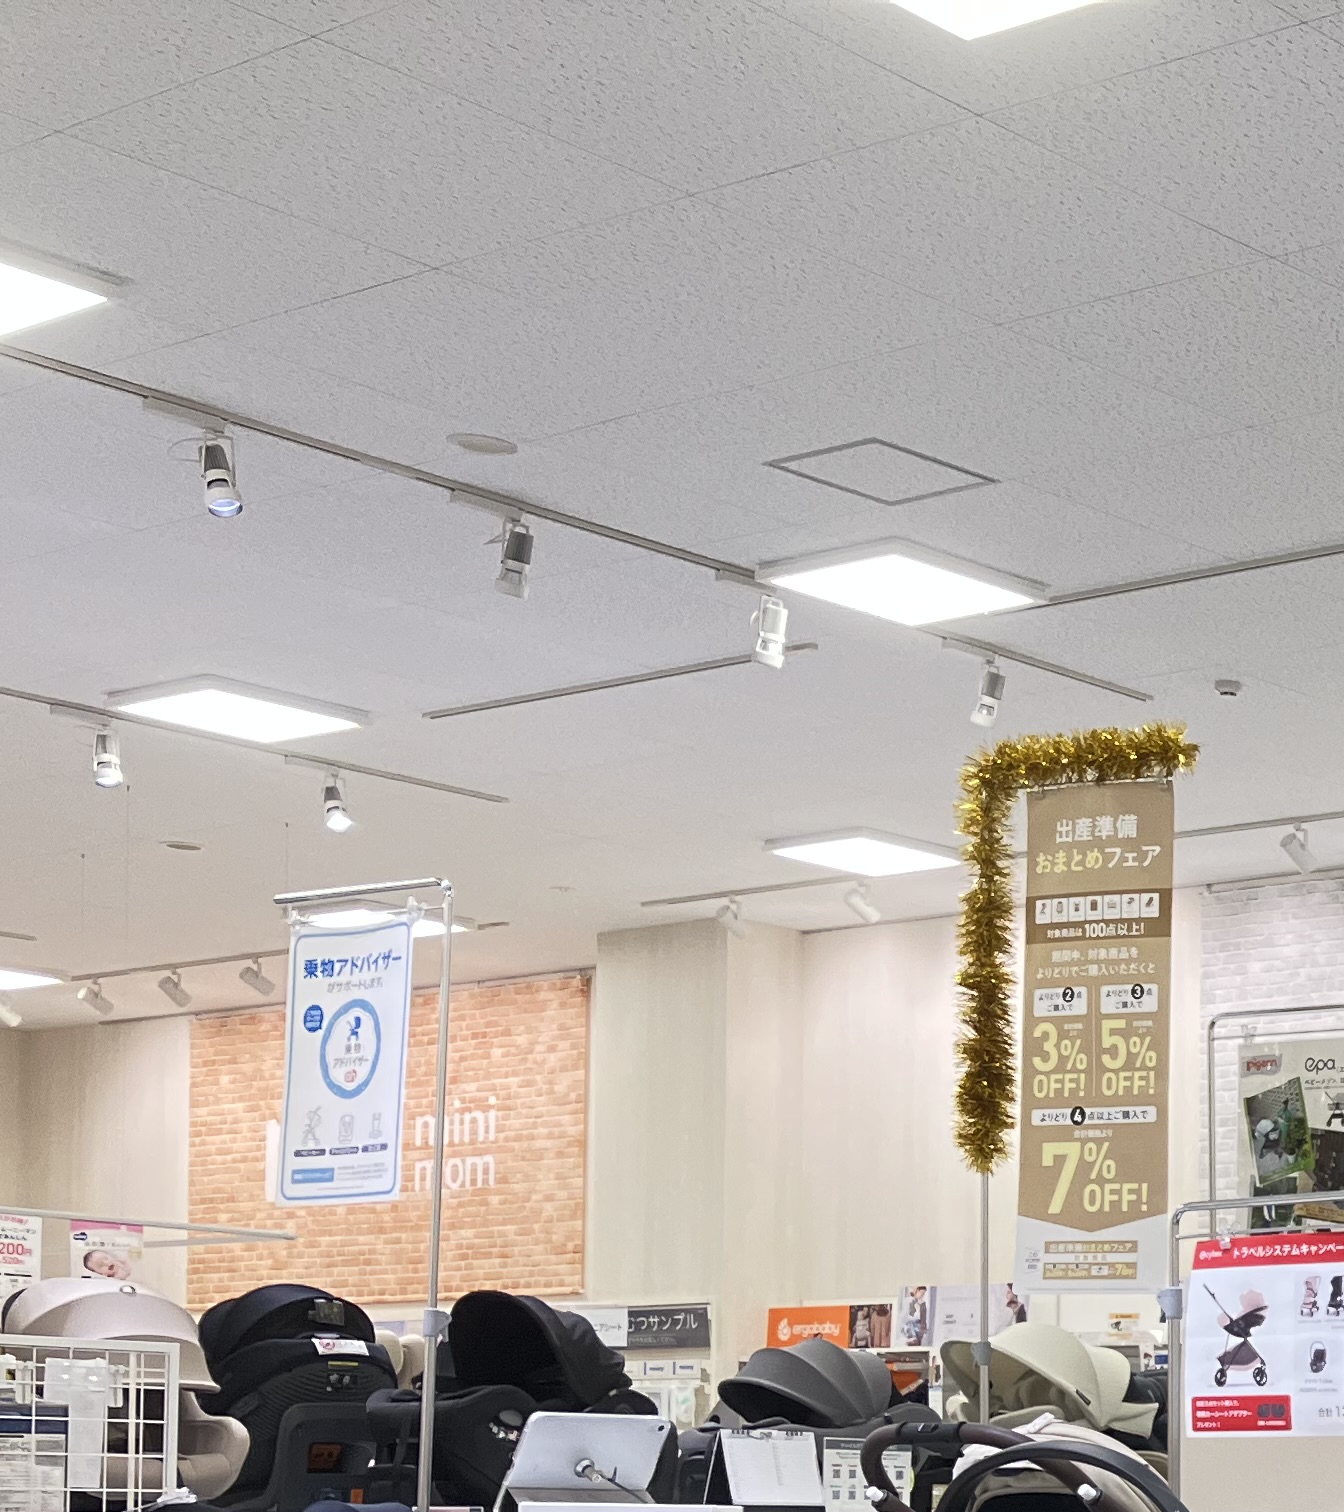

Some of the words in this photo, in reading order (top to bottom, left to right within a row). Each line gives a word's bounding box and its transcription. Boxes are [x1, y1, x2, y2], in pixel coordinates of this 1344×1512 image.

[1056, 815, 1137, 843] 出産準備
[1036, 845, 1160, 874] おまとめフェア
[303, 950, 402, 979] 乗物アドバイザー
[1305, 1058, 1336, 1075] epa
[1033, 1073, 1085, 1098] OFF!
[1102, 1071, 1154, 1096] OFF!
[1084, 1183, 1148, 1213] OFF!
